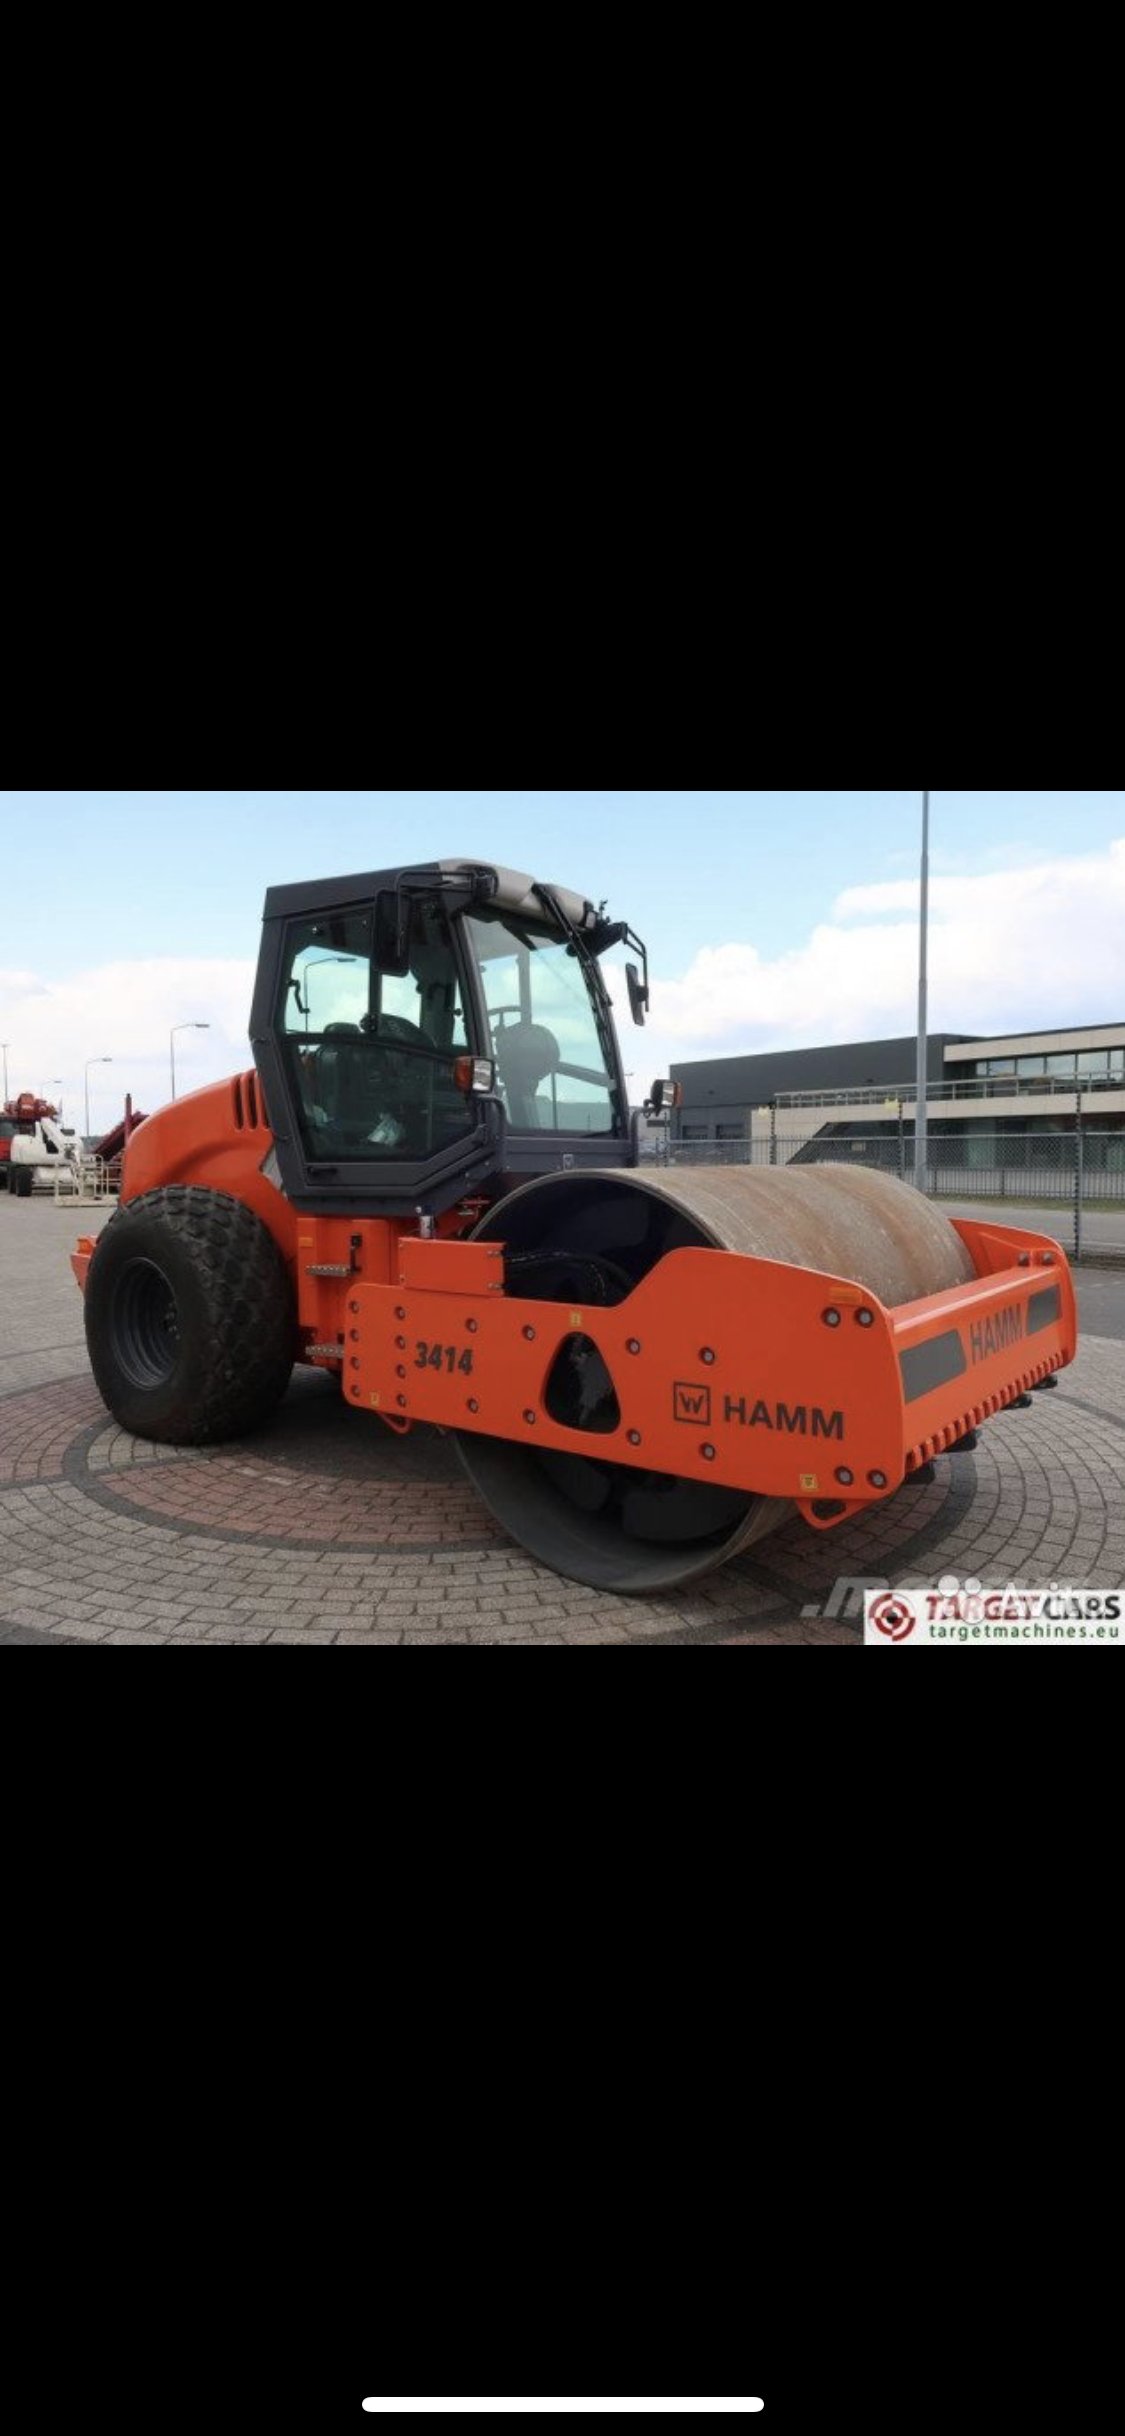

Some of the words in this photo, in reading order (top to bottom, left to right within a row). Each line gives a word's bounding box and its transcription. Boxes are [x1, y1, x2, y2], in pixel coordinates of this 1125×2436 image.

[969, 1303, 1025, 1365] HAMM
[414, 1341, 473, 1376] 3414
[723, 1394, 845, 1441] HAMM
